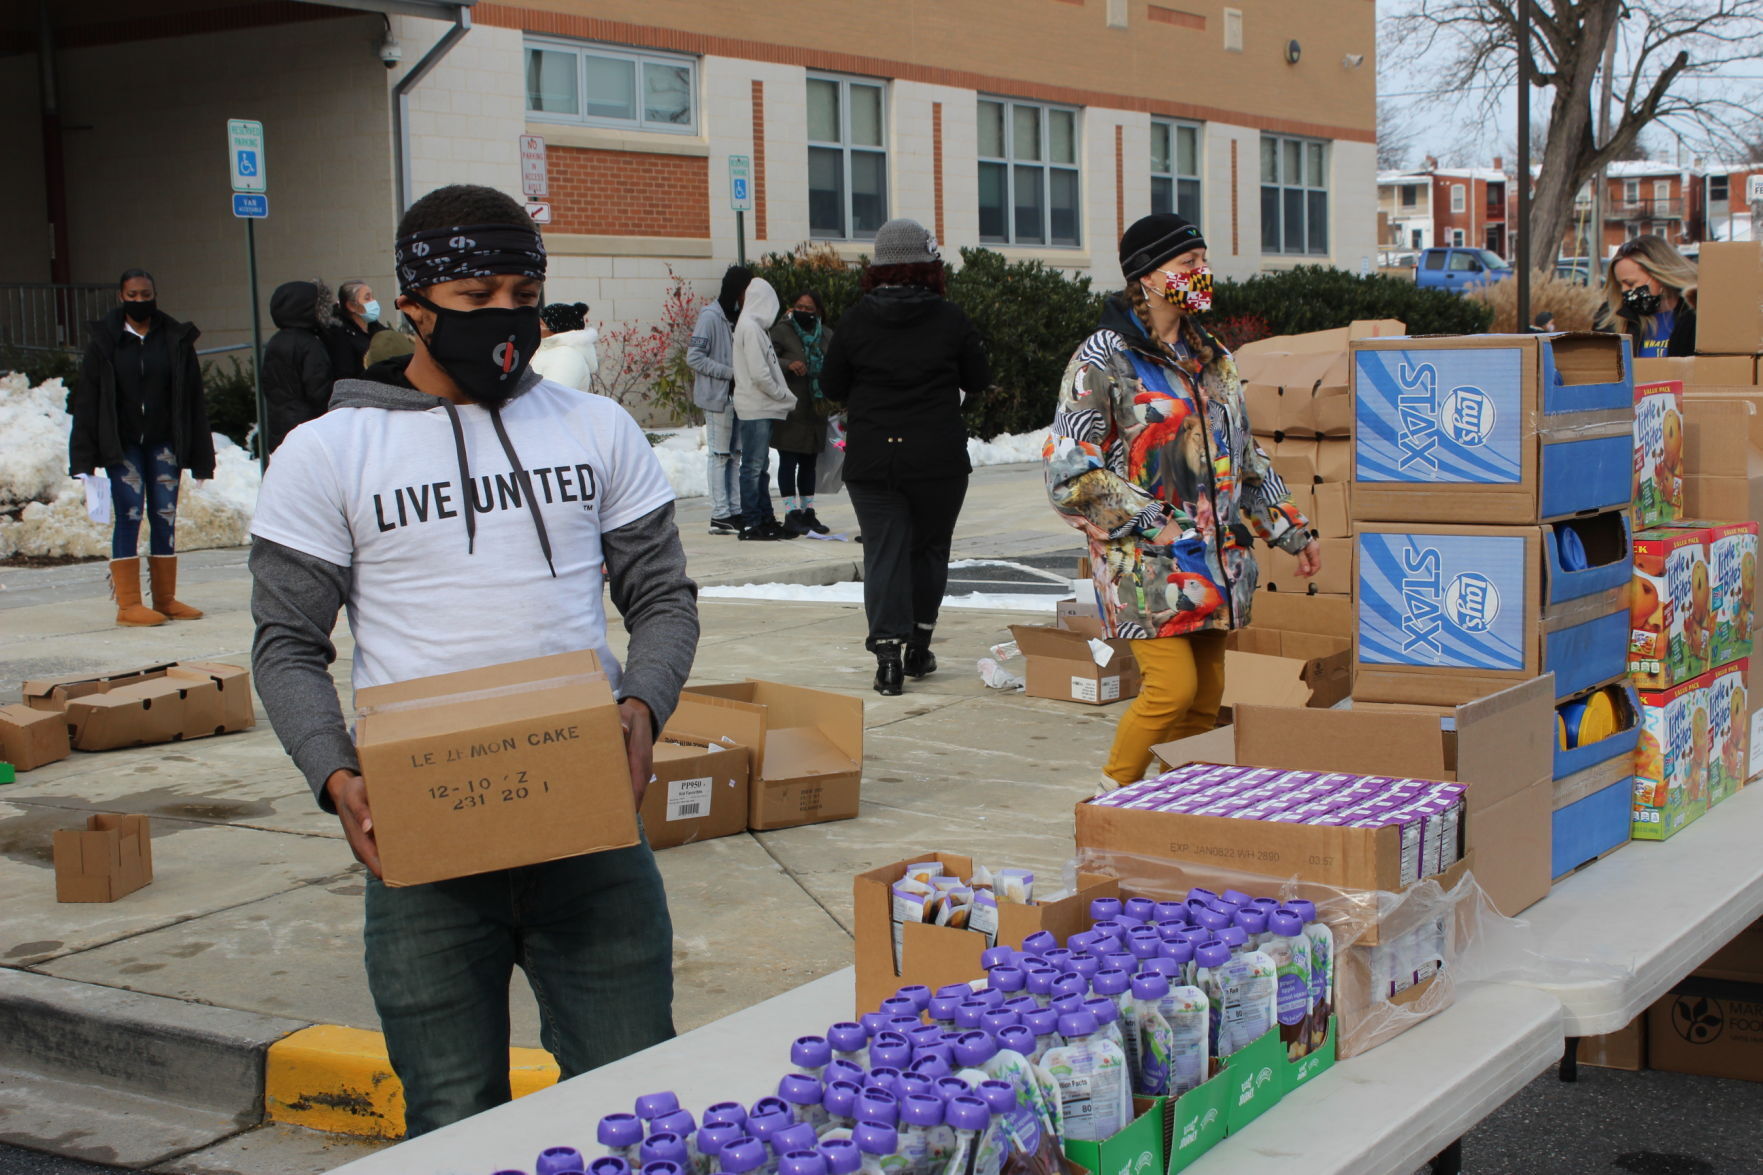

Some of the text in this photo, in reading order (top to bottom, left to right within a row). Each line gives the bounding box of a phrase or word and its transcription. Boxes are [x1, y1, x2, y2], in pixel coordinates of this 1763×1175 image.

[522, 152, 545, 160] PARKING
[527, 139, 537, 150] NO
[1398, 362, 1438, 472] STAX
[1452, 390, 1484, 444] Lay's
[1637, 400, 1656, 443] Little
[1644, 424, 1663, 458] Bites
[373, 481, 458, 533] LIVE
[1667, 553, 1685, 598] Little
[1718, 541, 1735, 583] Little
[1722, 562, 1741, 597] Bites
[1402, 546, 1442, 656] STAX
[1457, 576, 1488, 630] Lay's
[1674, 576, 1692, 613] Bites
[1709, 681, 1725, 725] Little
[1714, 702, 1730, 739] Bites
[527, 726, 580, 746] CAKE
[1669, 701, 1686, 748] Little
[1674, 721, 1692, 762] Bites
[1170, 843, 1189, 853] EXP
[1072, 1079, 1088, 1087] Facts
[1081, 1104, 1092, 1113] 80
